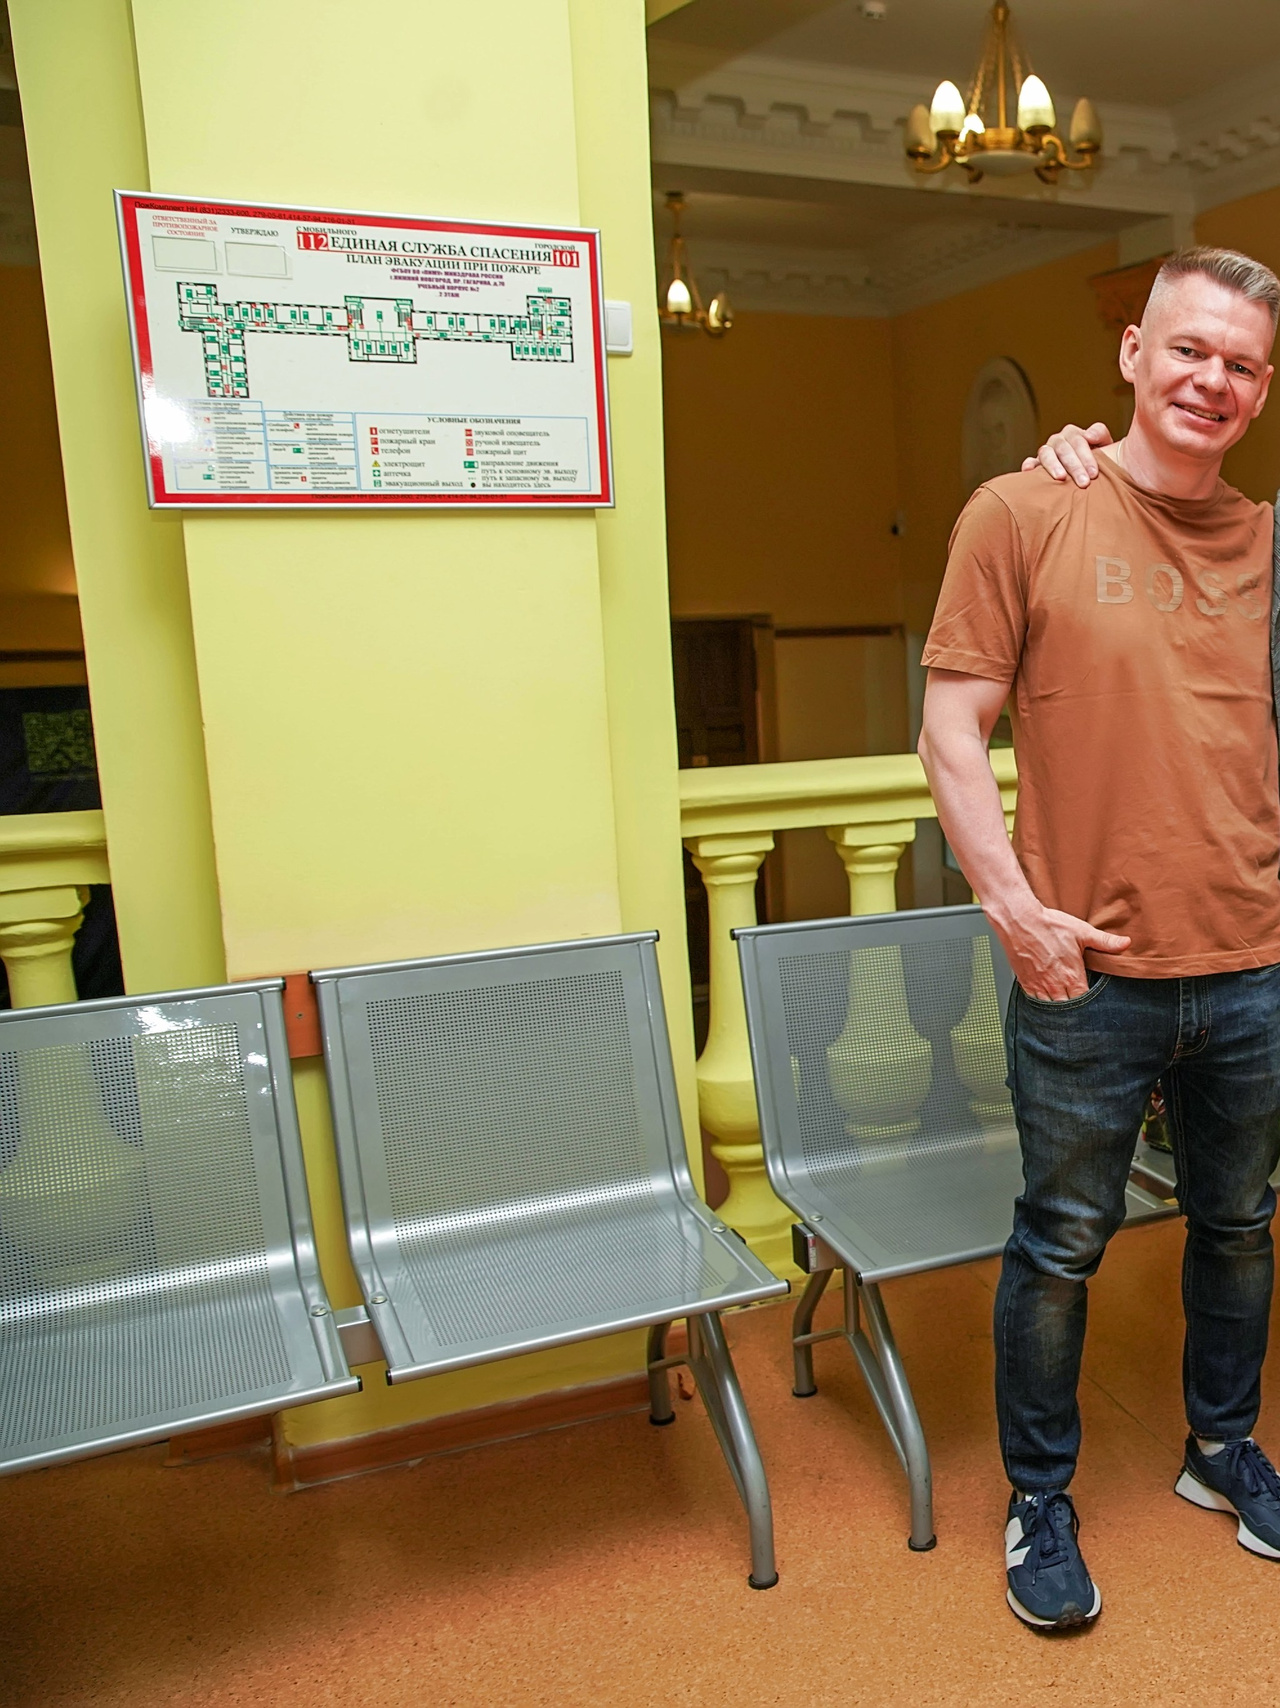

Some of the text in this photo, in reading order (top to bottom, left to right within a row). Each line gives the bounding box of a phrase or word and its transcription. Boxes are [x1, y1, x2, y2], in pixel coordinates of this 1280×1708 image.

[152, 215, 208, 225] ОТВЕТСТВЕННЫЙ
[152, 222, 218, 232] ПРОТИВОПОЖАРНОЕ
[230, 226, 279, 237] УТВЕРЖДАЮ
[302, 226, 357, 236] МОБИЛЬНОГО
[166, 229, 205, 237] СОСТОЯНИЕ
[297, 233, 552, 262] 112 ЕДИНАЯ СЛУЖБА СПАСЕНИЯ
[534, 242, 576, 251] ГОРОДСКОЙ
[554, 251, 580, 267] 101
[346, 254, 541, 275] ПЛАН ЭВАКУАЦИИ ПРИ ПОЖАРЕ
[378, 428, 431, 436] огнетушители
[380, 438, 417, 446] пожарный
[381, 447, 411, 455] телефон
[476, 449, 511, 457] пожарный
[1095, 555, 1262, 620] BOSS
